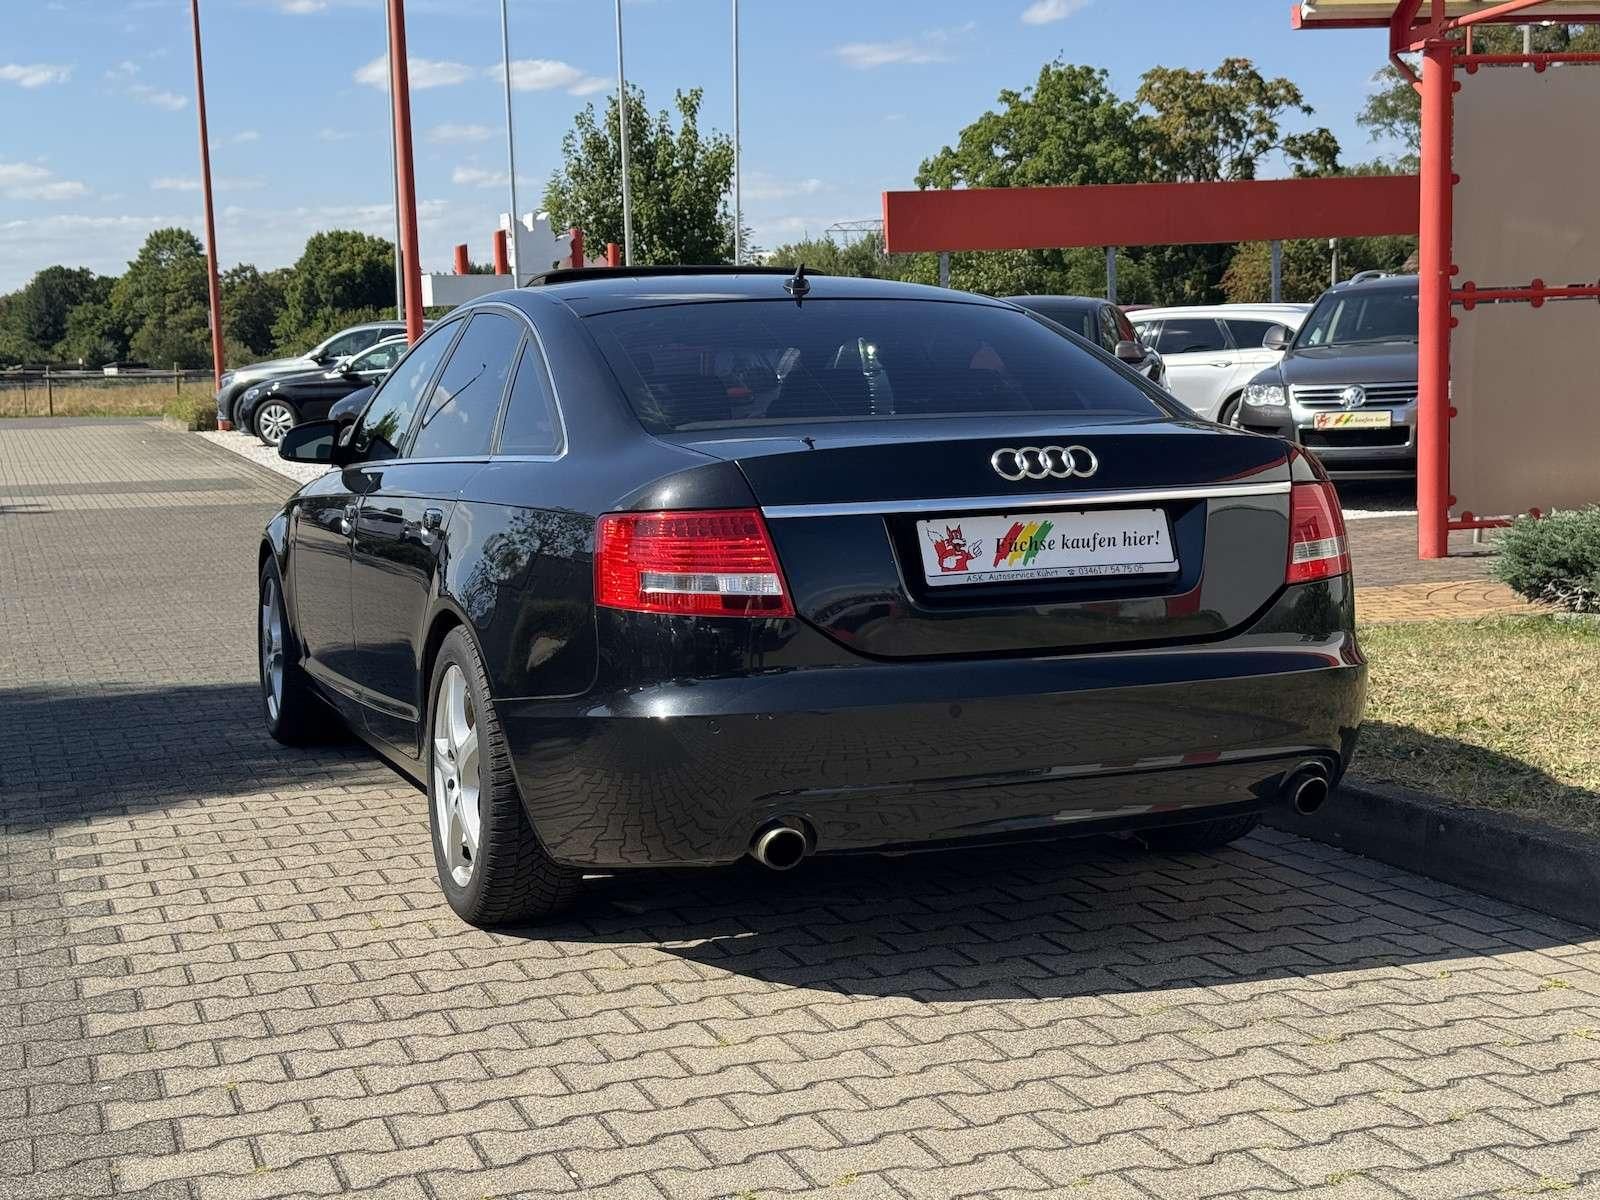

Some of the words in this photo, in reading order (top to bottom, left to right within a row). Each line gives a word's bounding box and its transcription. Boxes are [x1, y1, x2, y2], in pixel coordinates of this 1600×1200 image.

[1061, 533, 1116, 552] kaufen
[1122, 530, 1160, 547] hier!
[966, 574, 984, 583] ASK
[989, 569, 1034, 581] Autoservice
[1110, 564, 1121, 573] 54
